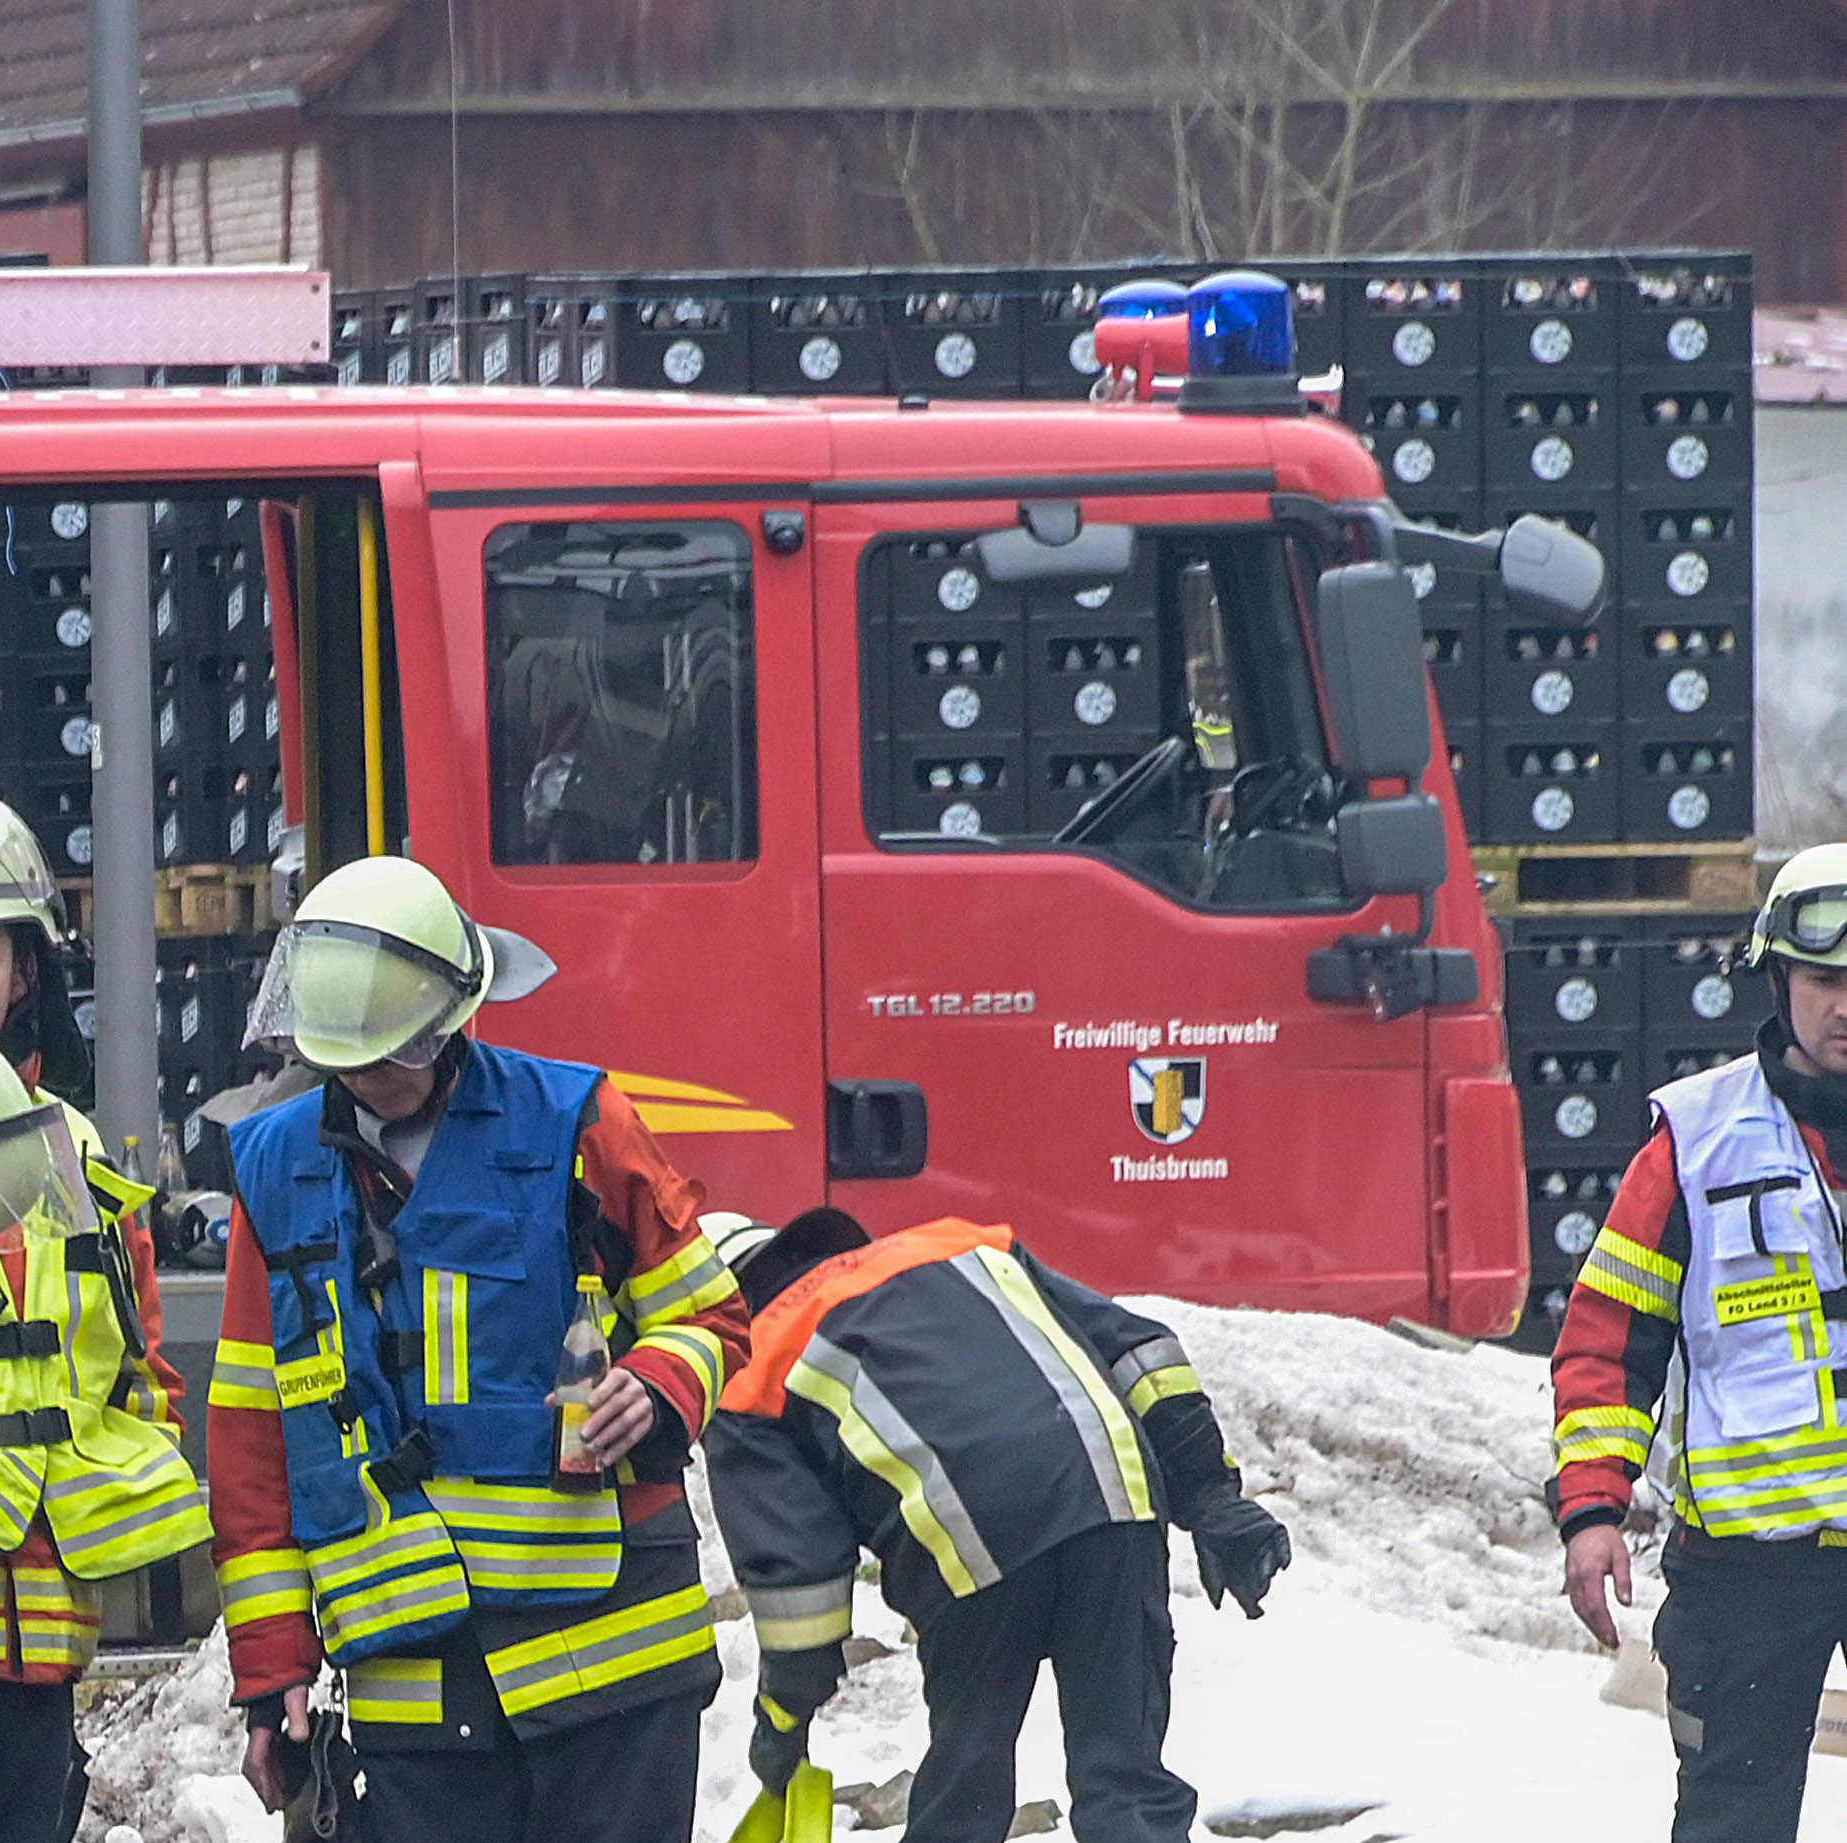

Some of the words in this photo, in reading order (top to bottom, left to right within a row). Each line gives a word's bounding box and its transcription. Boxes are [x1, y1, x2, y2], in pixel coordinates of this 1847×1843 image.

[867, 994, 923, 1017] TGL
[929, 991, 1037, 1016] 12.220
[1053, 1020, 1162, 1051] Freiwillige
[1167, 1017, 1279, 1046] Feuerwehr
[1110, 1155, 1229, 1183] Thuisbrunn
